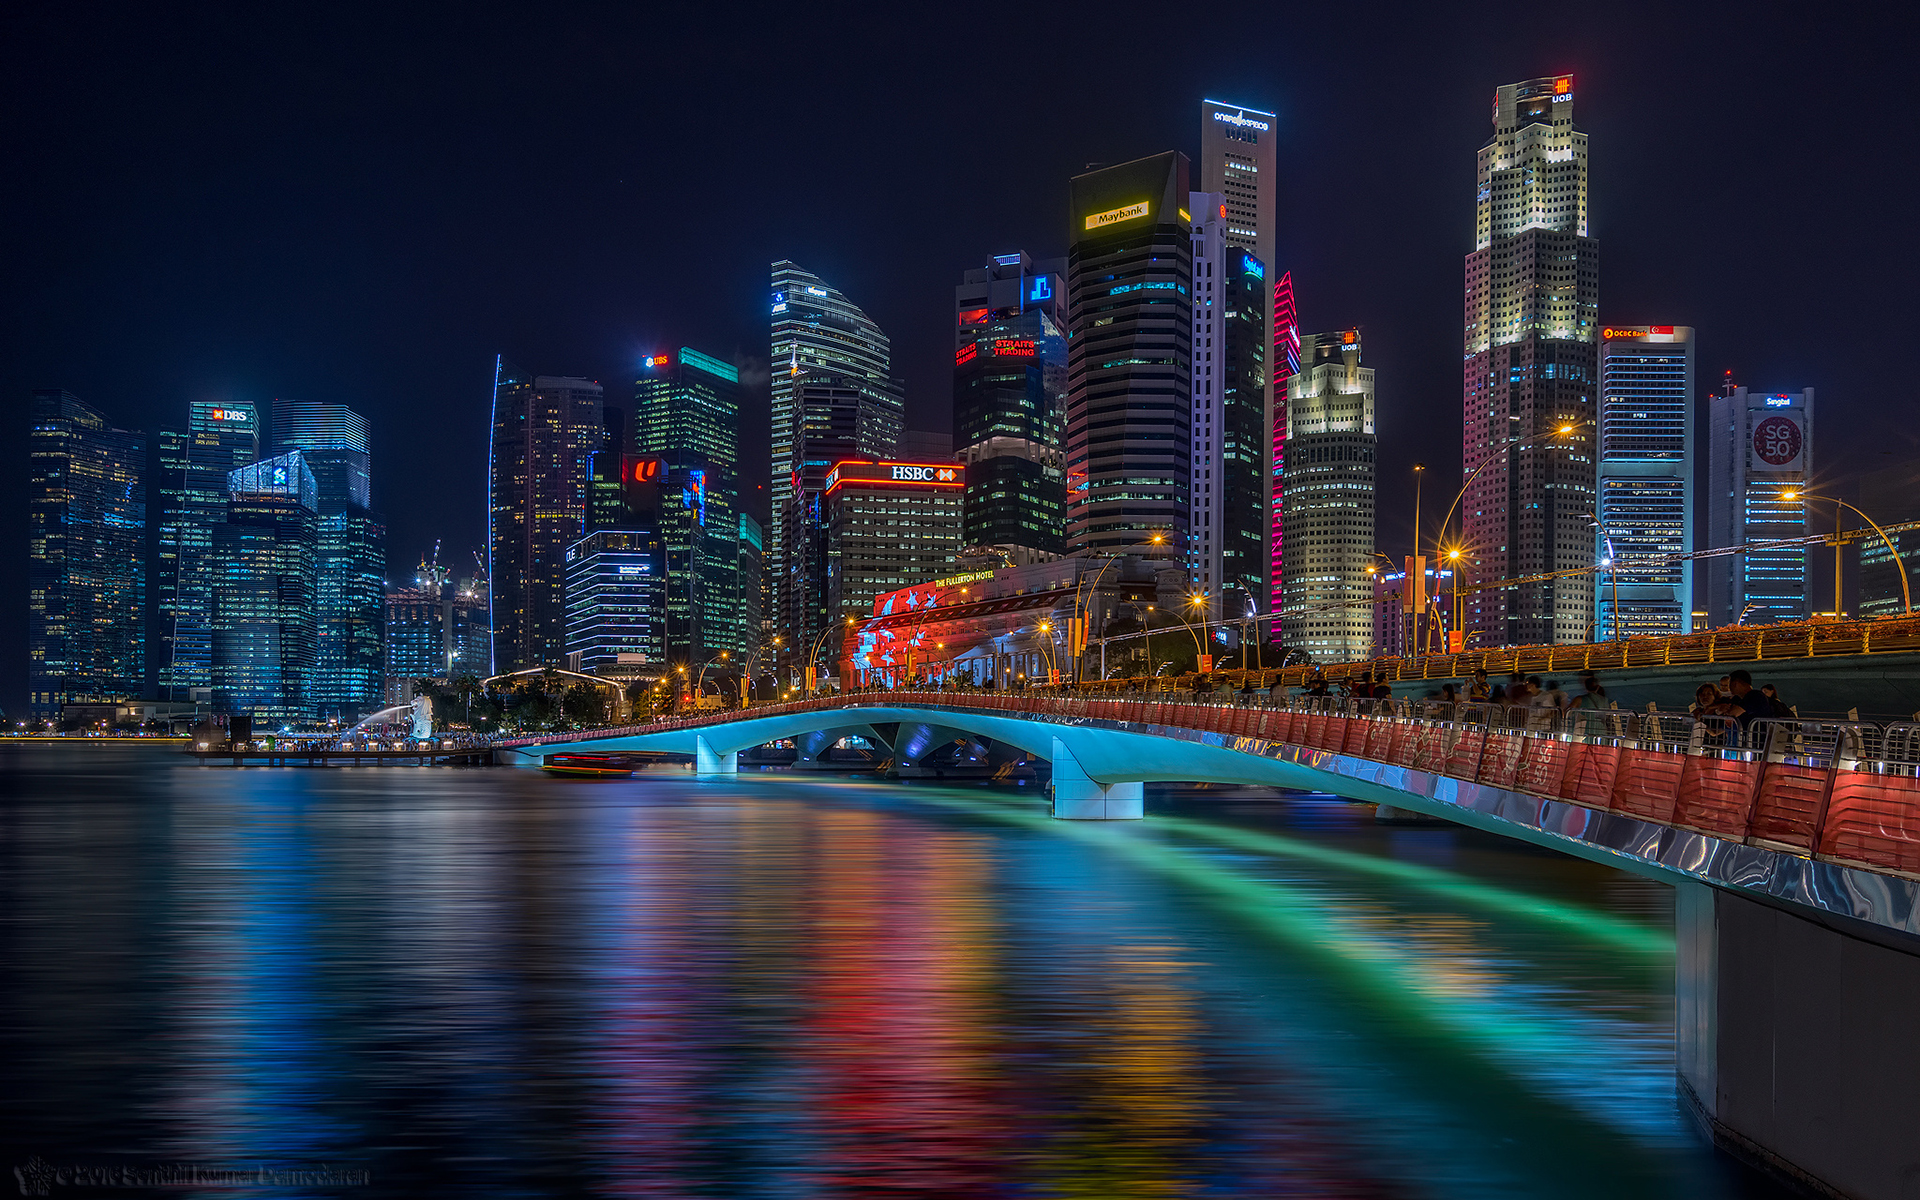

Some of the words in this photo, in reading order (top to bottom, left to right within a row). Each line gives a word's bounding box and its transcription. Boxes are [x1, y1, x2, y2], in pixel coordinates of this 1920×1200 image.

[1552, 93, 1572, 103] UOB
[1098, 206, 1143, 224] Maybank
[995, 339, 1034, 348] STRAITS
[1341, 344, 1358, 352] UOB
[993, 348, 1035, 356] TRADING
[653, 355, 668, 366] UBS
[223, 409, 247, 421] DBS
[1765, 424, 1790, 440] SG
[1765, 440, 1790, 457] 50
[891, 465, 934, 481] HSBC
[935, 579, 946, 588] THE
[945, 573, 975, 586] FULLERTON
[975, 570, 994, 580] HOTEL
[1537, 743, 1553, 764] SG
